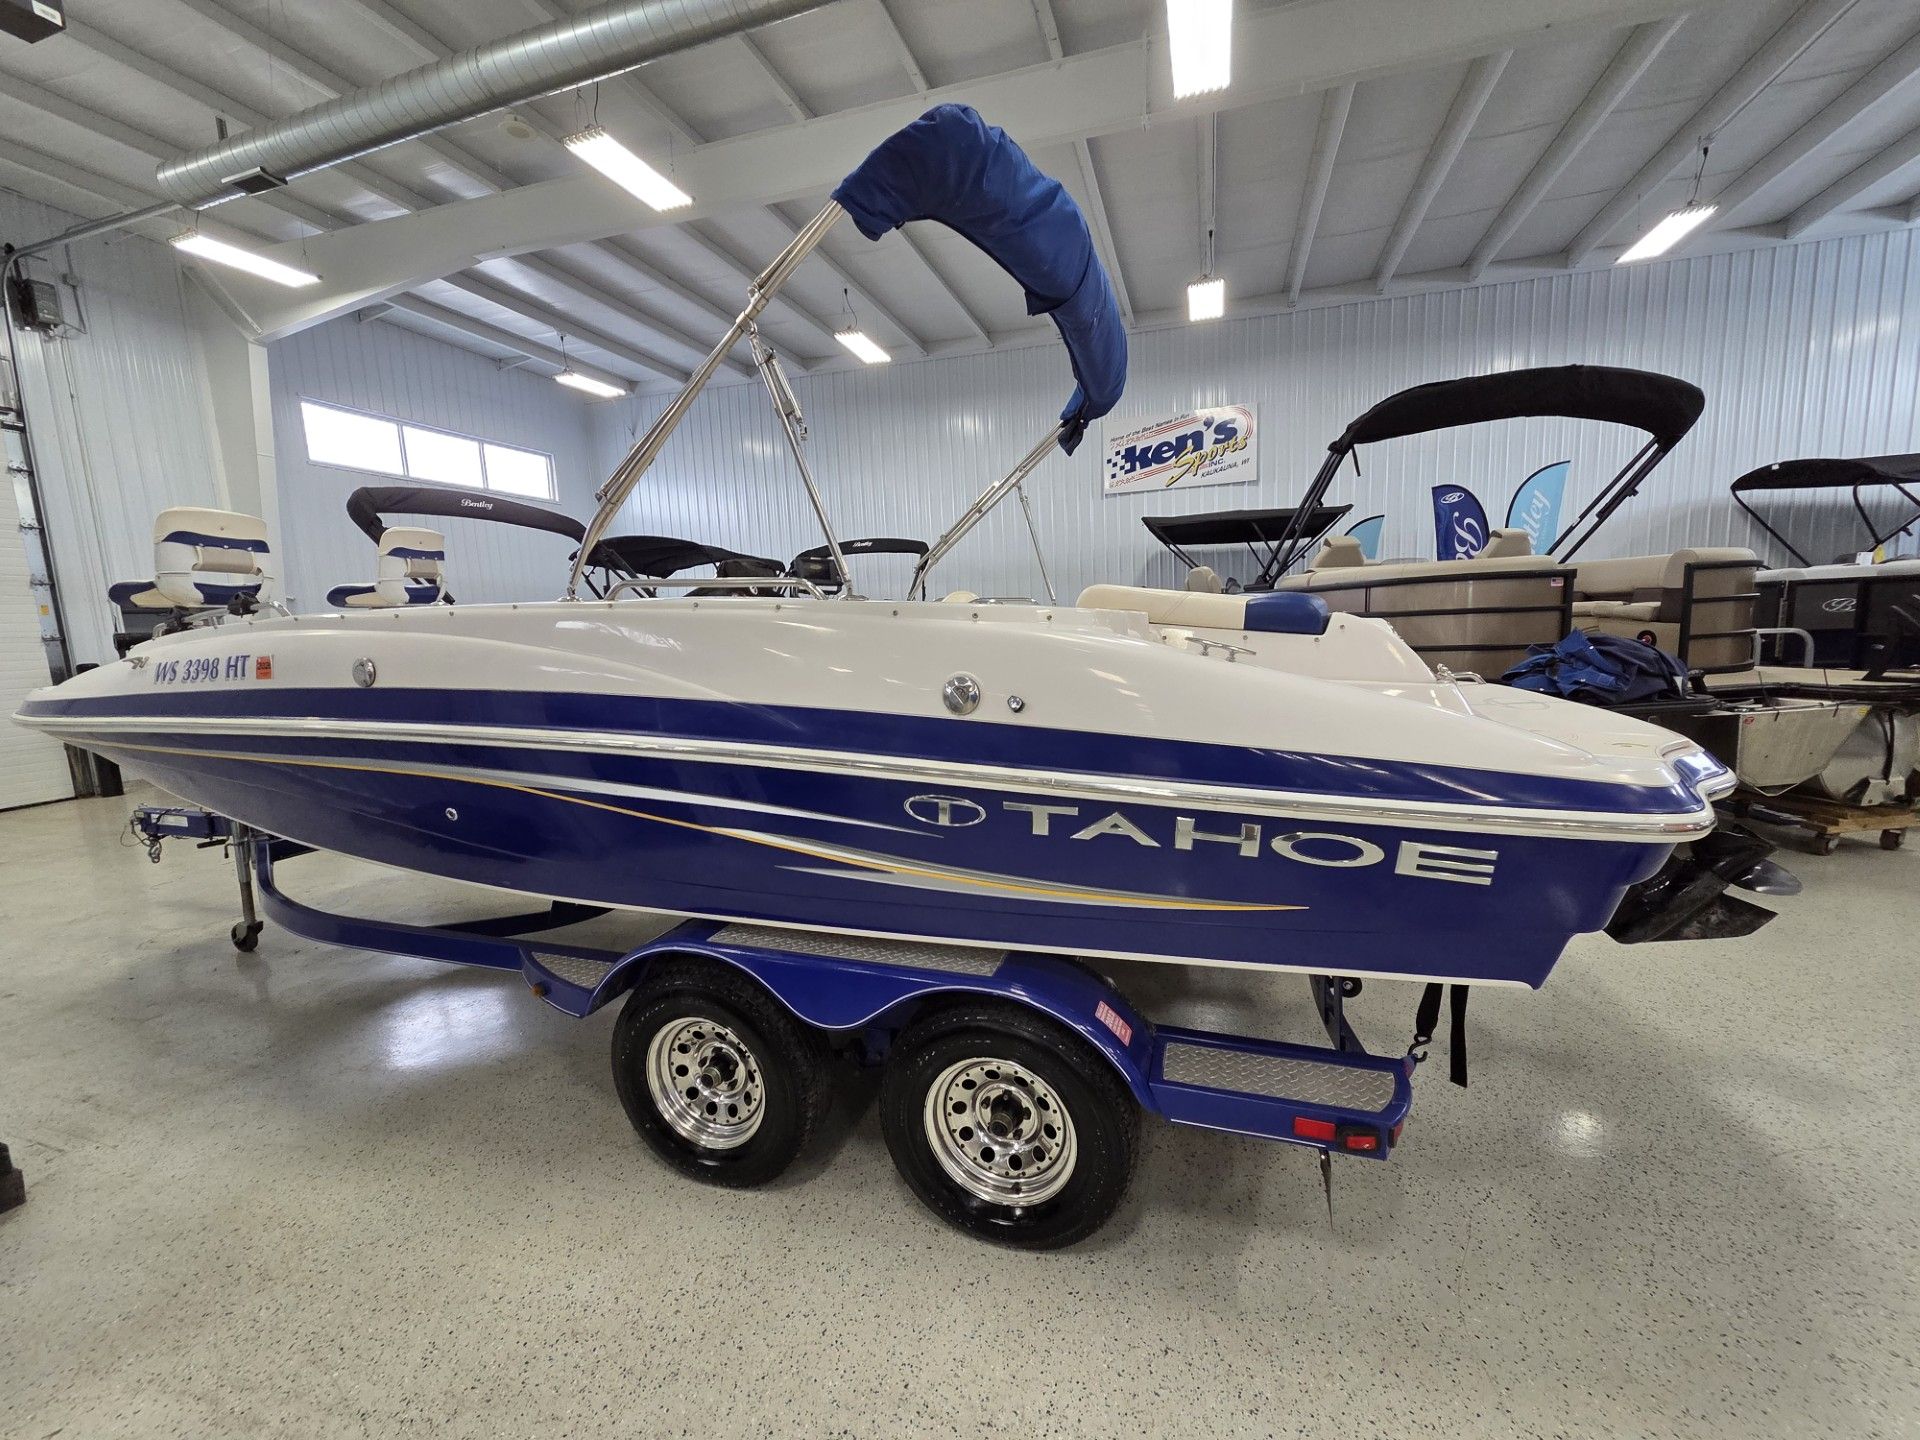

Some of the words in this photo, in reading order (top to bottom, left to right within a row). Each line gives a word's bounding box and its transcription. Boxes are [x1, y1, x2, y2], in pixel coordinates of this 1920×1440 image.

[1165, 436, 1248, 487] Sports
[460, 498, 493, 510] Bentley
[154, 660, 179, 683] WS
[182, 657, 220, 681] 3398
[225, 655, 250, 678] HT
[1003, 801, 1498, 886] TAHOE
